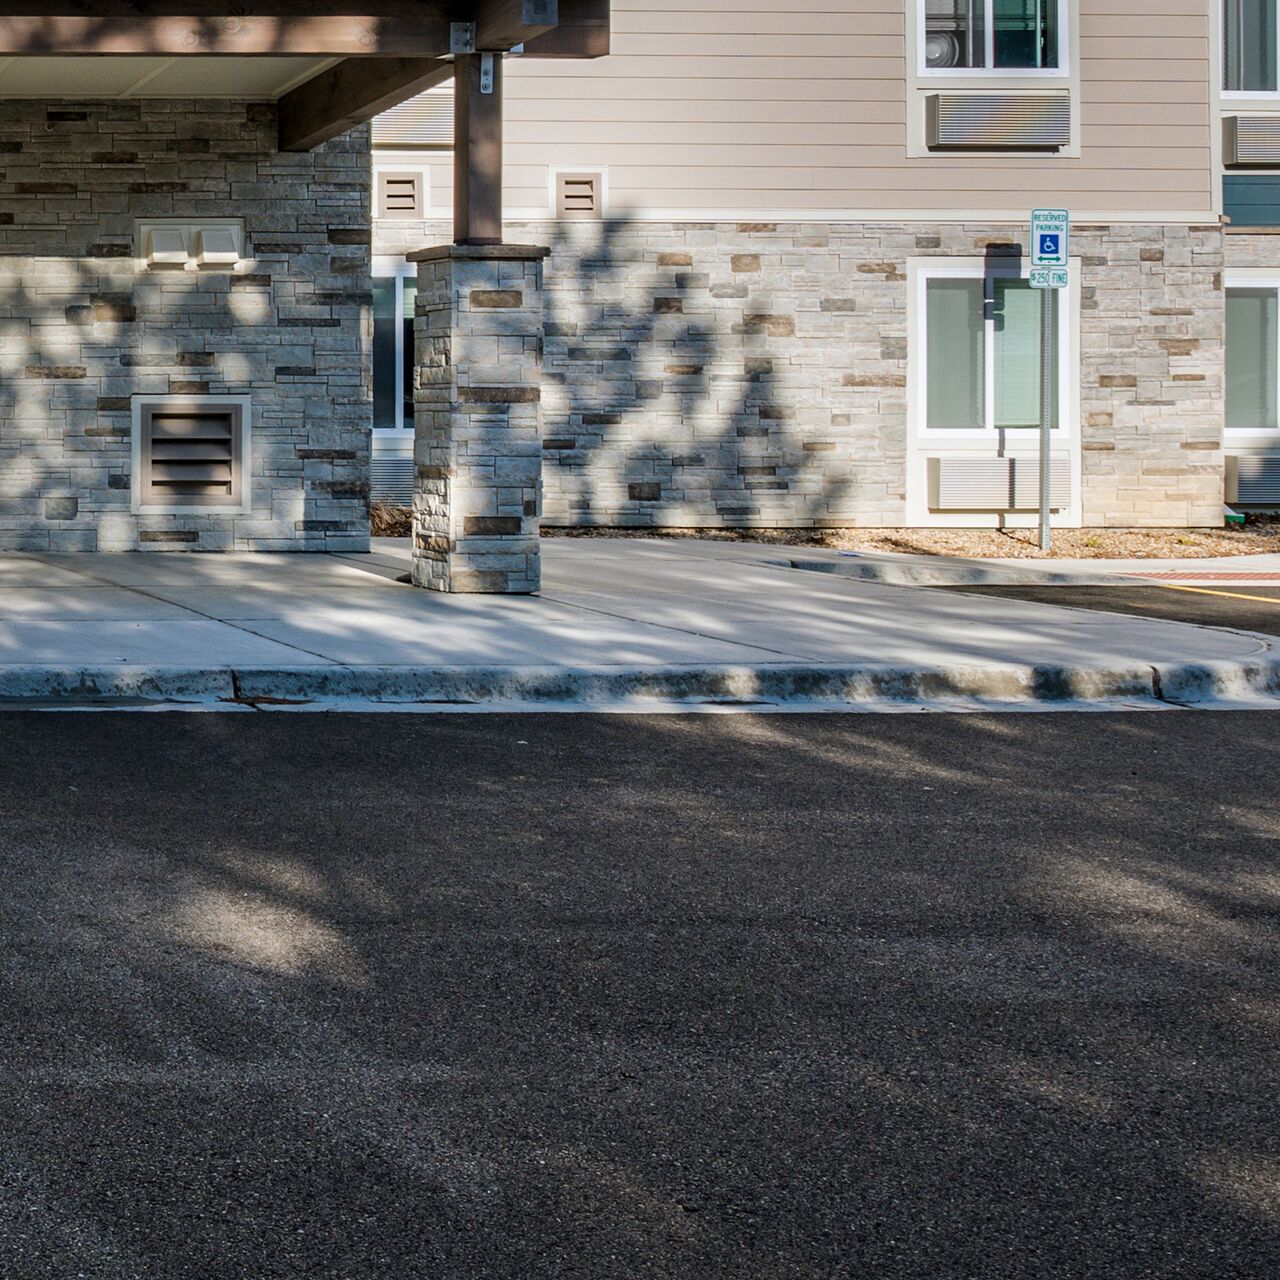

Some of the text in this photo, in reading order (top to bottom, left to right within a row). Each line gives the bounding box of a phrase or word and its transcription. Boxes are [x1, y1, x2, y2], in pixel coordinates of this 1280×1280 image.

[1033, 214, 1066, 222] RESERVED
[1035, 223, 1064, 231] PARKING
[1052, 272, 1067, 283] FINE
